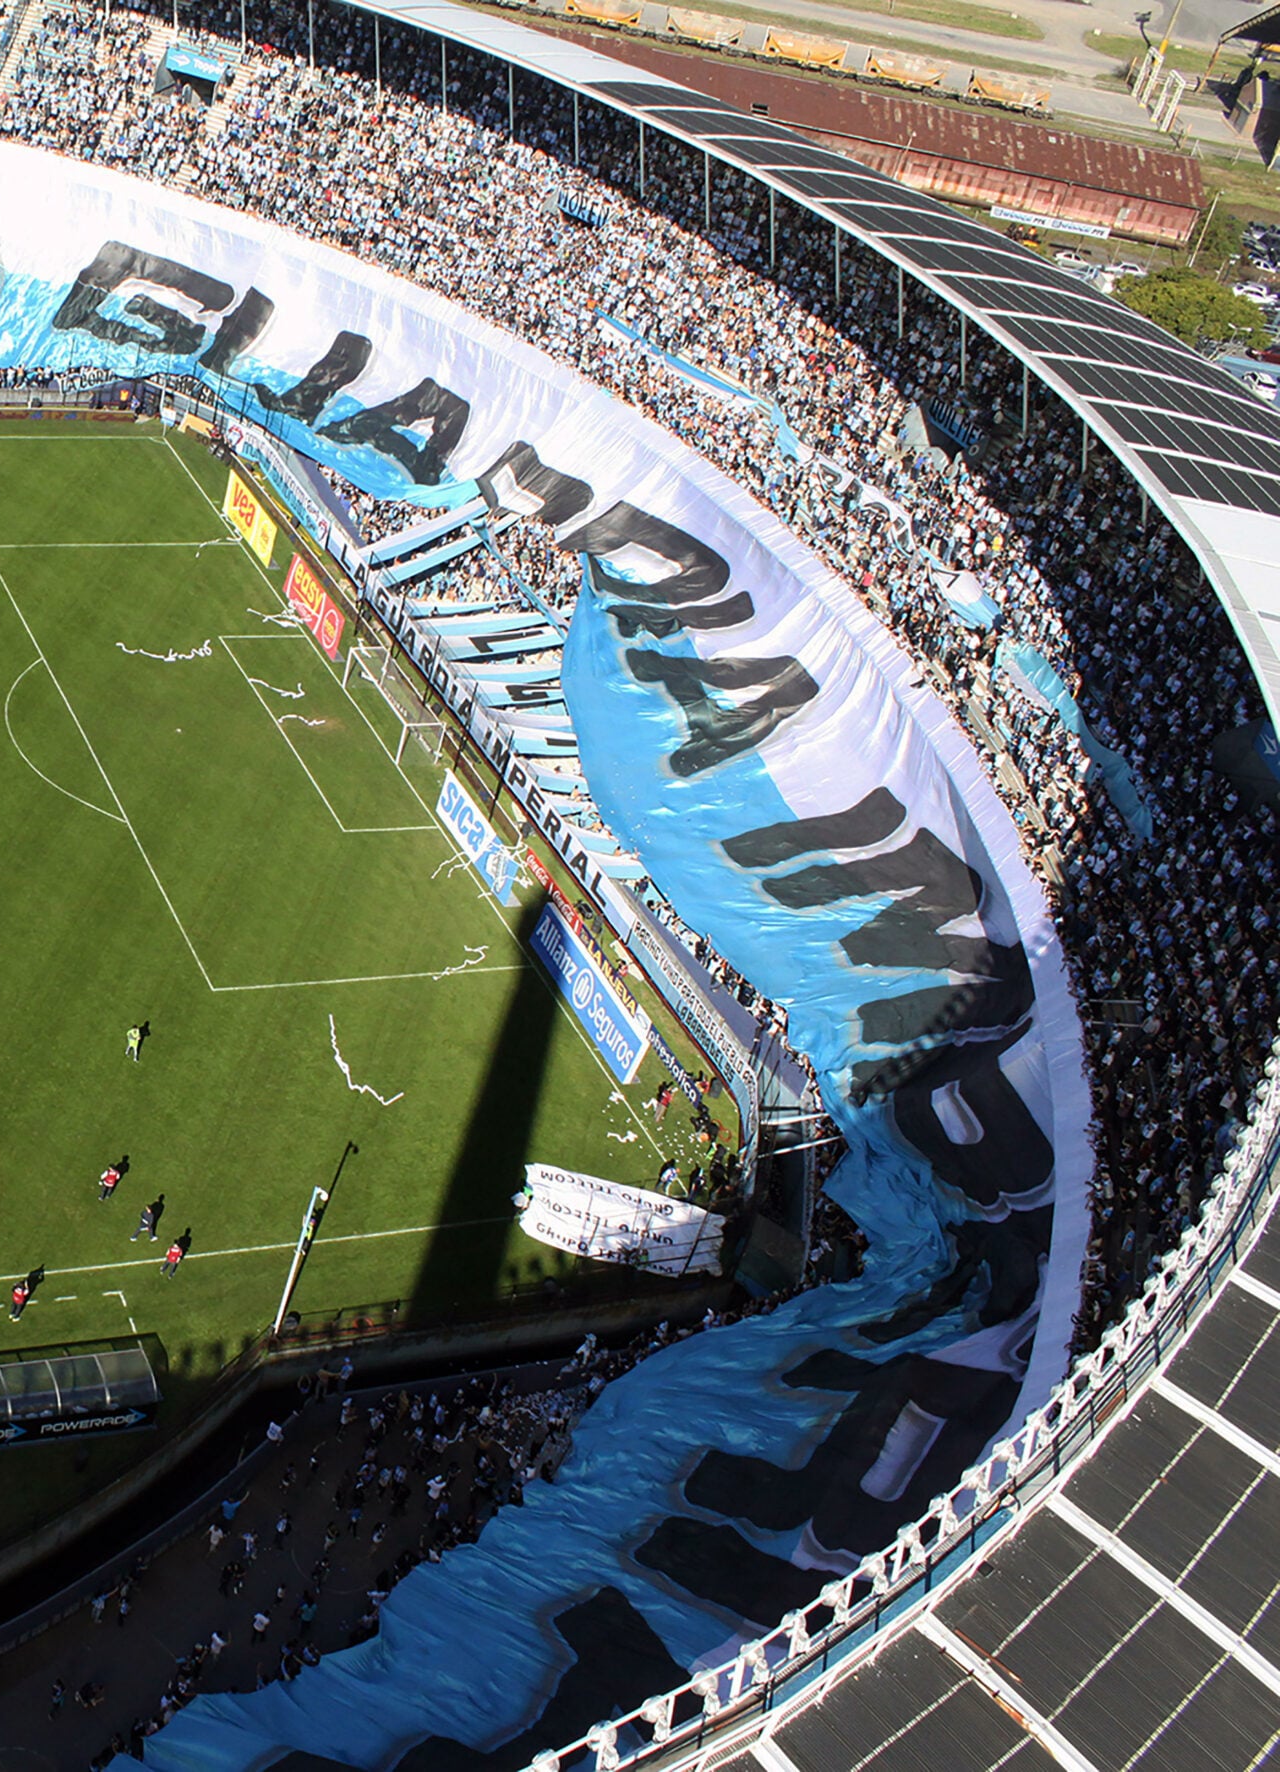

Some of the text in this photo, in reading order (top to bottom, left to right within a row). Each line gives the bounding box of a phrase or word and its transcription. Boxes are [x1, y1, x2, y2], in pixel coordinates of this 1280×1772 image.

[294, 563, 323, 612] easy
[340, 544, 606, 907] LA GUARDIA IMPERIAL
[536, 915, 579, 984] Allianz
[587, 992, 634, 1069] Seguros
[40, 1413, 136, 1434] POWERADE
